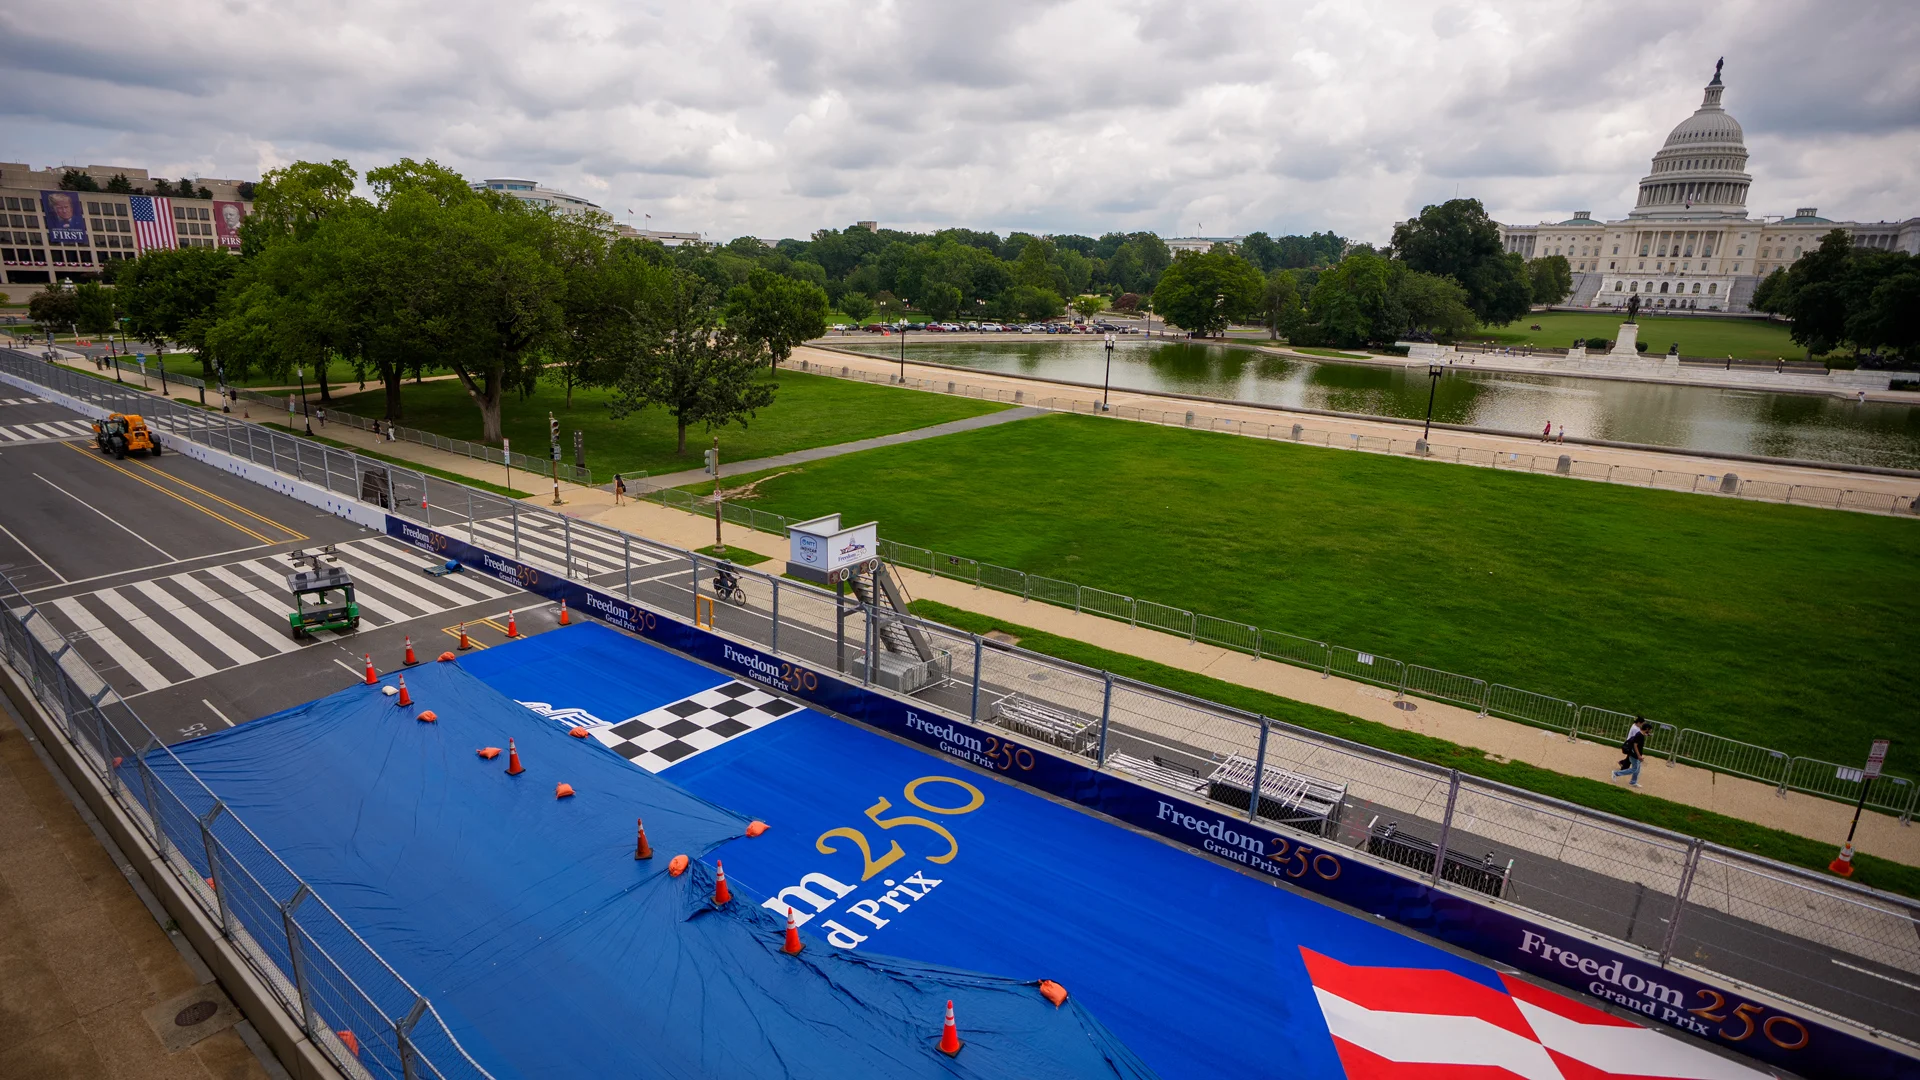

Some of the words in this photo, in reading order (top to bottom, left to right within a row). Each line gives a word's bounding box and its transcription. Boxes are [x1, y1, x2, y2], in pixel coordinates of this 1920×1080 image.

[52, 230, 83, 240] FIRST
[221, 237, 241, 245] FIRS
[402, 524, 429, 543] Freedom
[429, 532, 447, 551] 250
[415, 540, 427, 549] Grand
[426, 543, 435, 552] Prix
[484, 554, 517, 576] Freedom
[517, 564, 538, 586] 250
[838, 552, 856, 562] Freedom
[499, 572, 513, 583] Grand
[512, 577, 523, 587] Prix
[586, 592, 628, 619] Freedom
[629, 606, 656, 632] 250
[605, 613, 623, 626] Grand
[623, 620, 636, 631] Prix
[723, 644, 780, 678] Freedom
[780, 663, 818, 692] 250
[748, 669, 772, 685] Grand
[773, 678, 789, 691] Prix
[905, 710, 982, 753] Freedom
[983, 737, 1035, 771] 250
[939, 741, 970, 760] Grand
[973, 752, 995, 769] Prix
[815, 776, 985, 881] 250
[1156, 800, 1265, 856] Freedom
[1266, 837, 1342, 881] 250
[1203, 838, 1248, 864] Grand
[1250, 855, 1282, 876] Prix
[845, 870, 943, 930] Prix
[1517, 929, 1685, 1010] Freedom
[1686, 989, 1810, 1050] 250
[1588, 981, 1656, 1017] Grand
[1660, 1008, 1711, 1037] Prix
